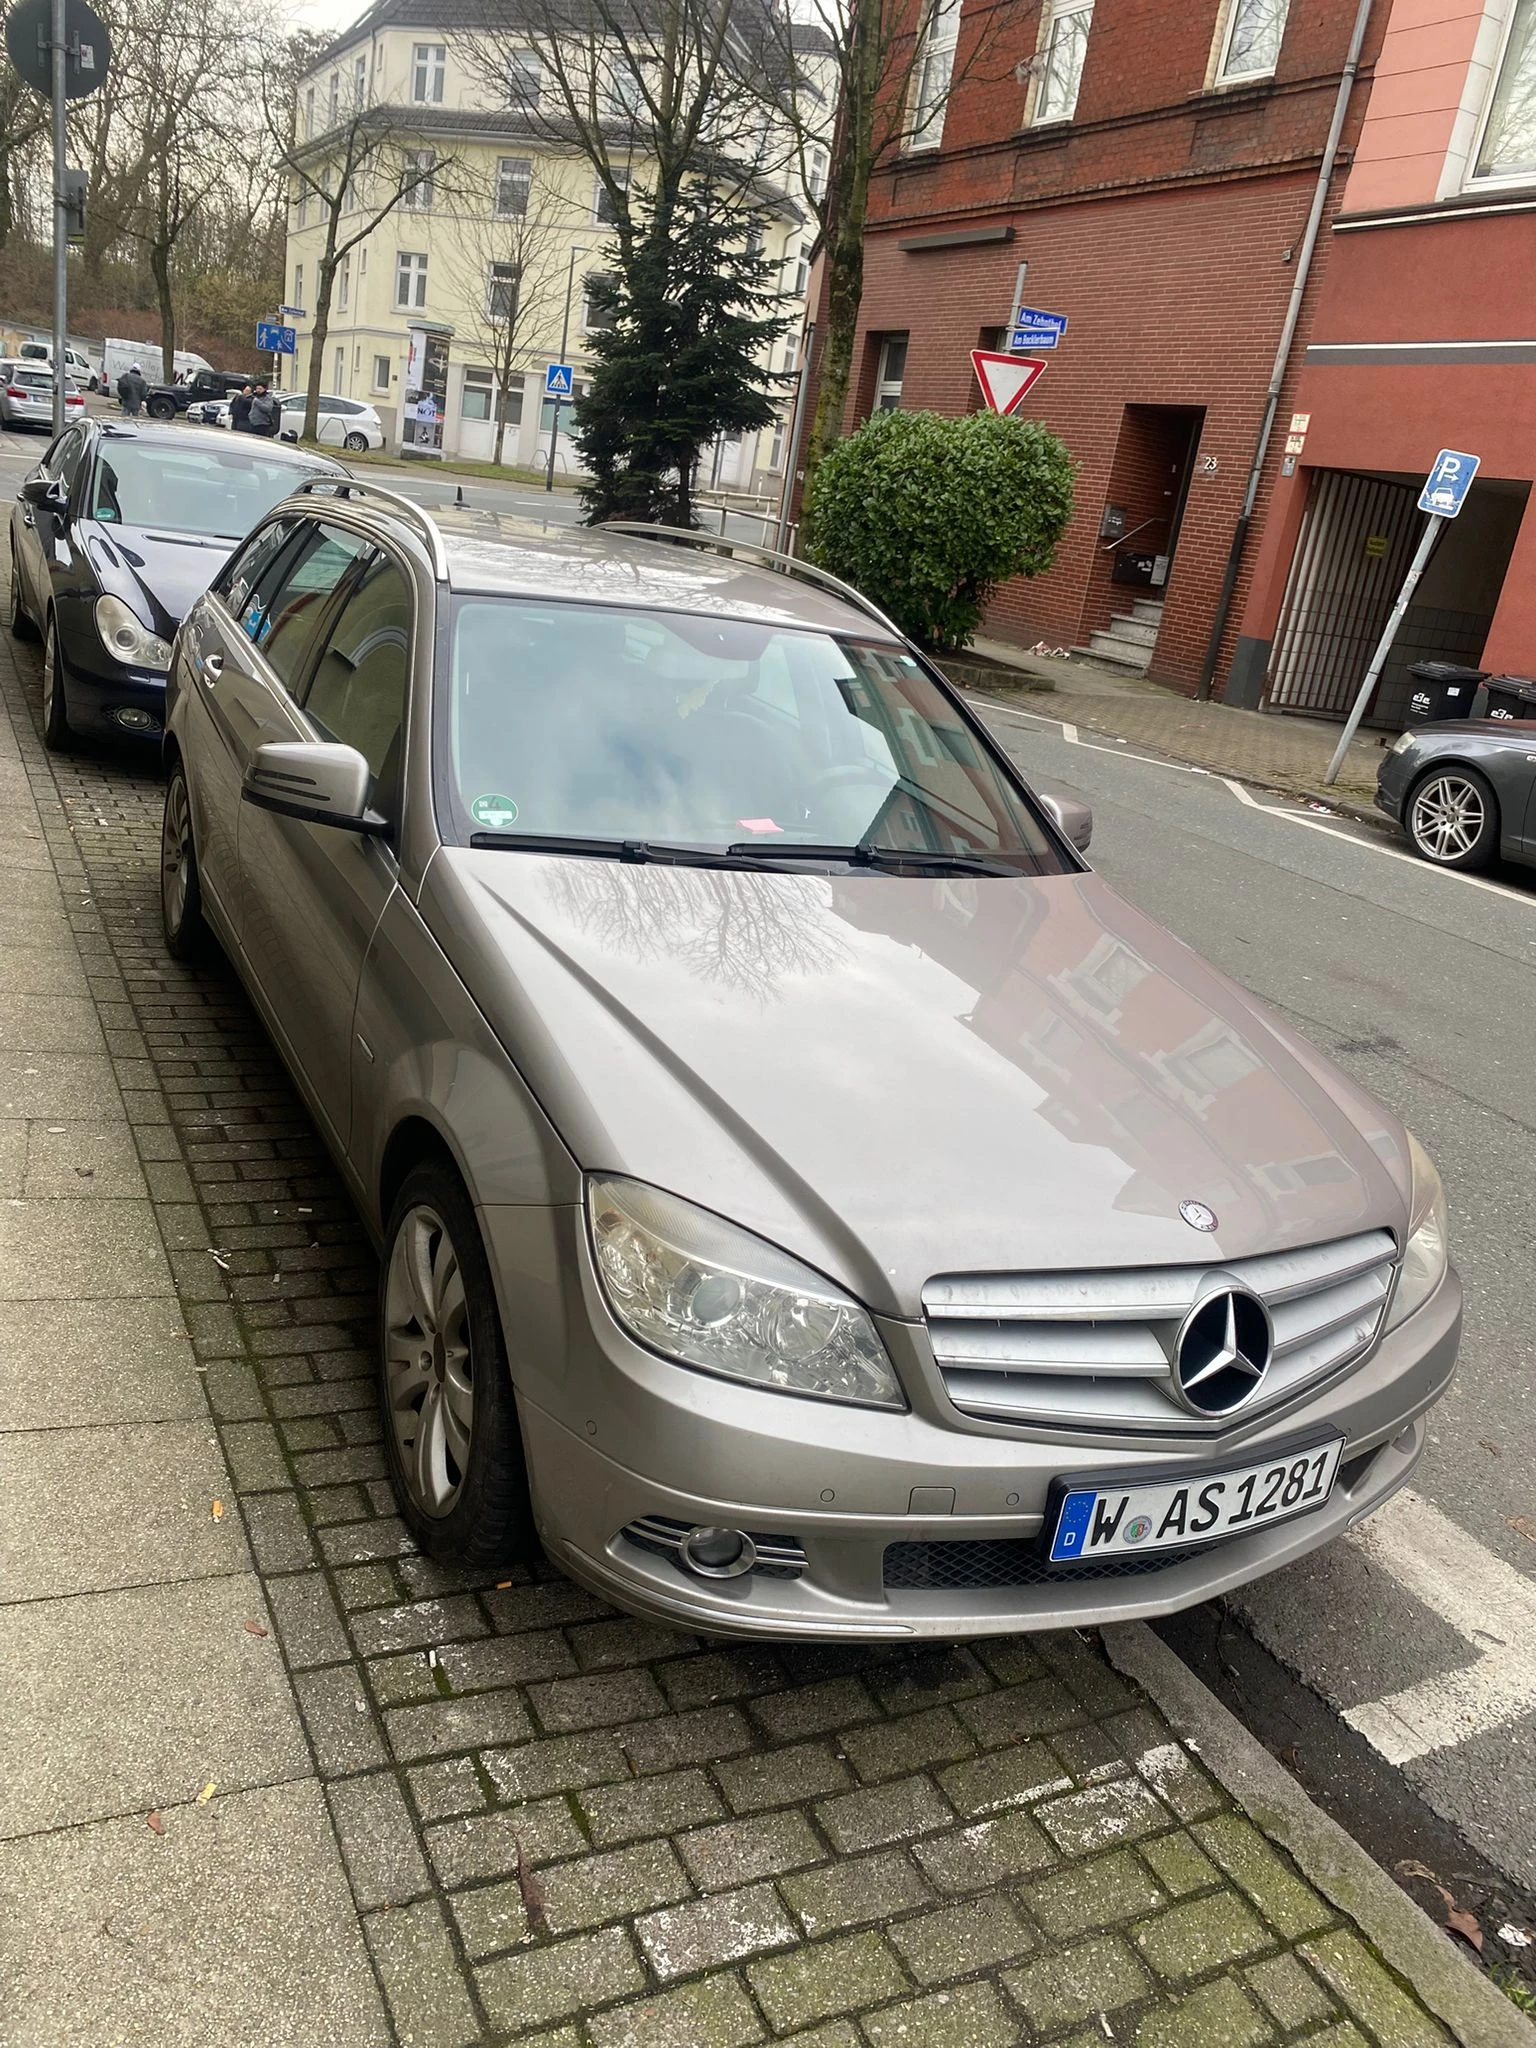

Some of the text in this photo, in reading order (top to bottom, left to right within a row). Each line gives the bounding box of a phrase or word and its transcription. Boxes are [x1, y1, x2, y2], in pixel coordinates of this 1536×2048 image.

[1020, 311, 1032, 324] Am
[1204, 456, 1217, 470] 23
[1436, 456, 1461, 482] P
[1090, 1496, 1130, 1547] W
[1063, 1532, 1076, 1547] D
